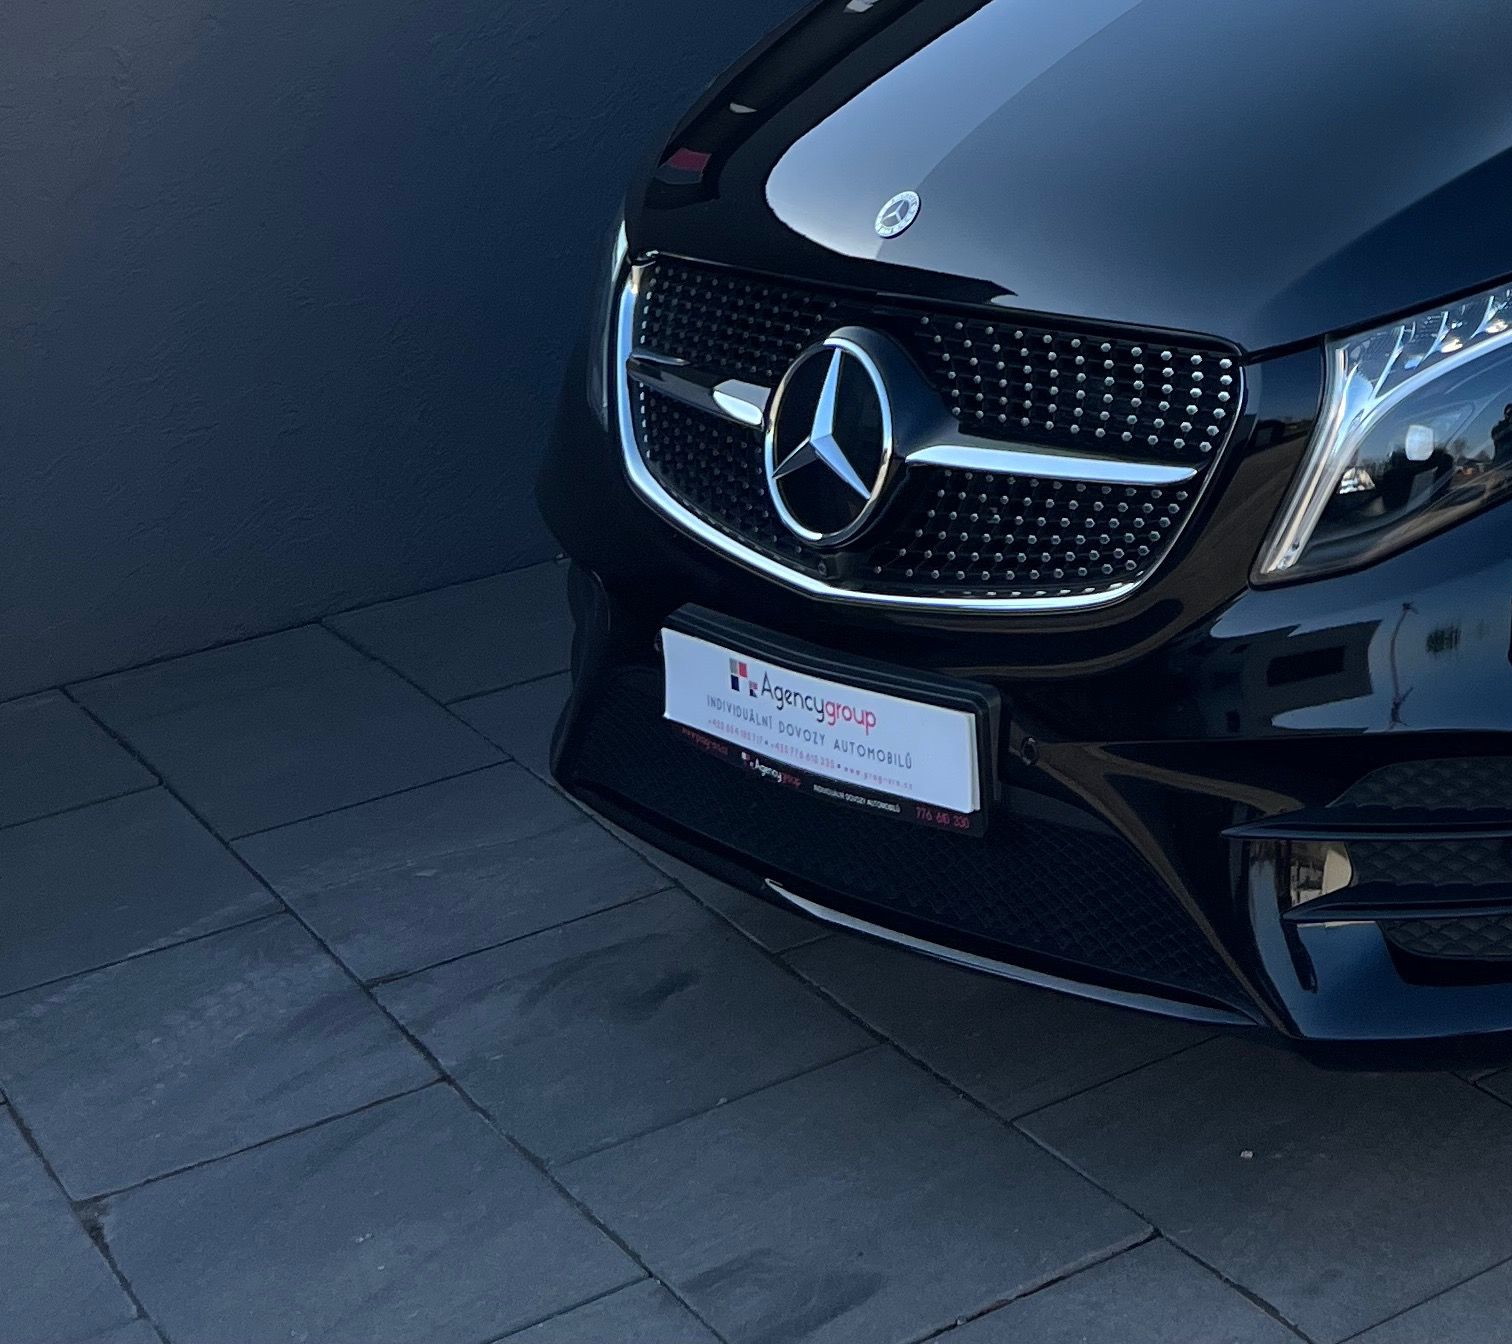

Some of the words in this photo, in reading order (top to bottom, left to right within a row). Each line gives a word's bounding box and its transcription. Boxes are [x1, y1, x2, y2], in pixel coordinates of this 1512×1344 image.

[760, 670, 877, 736] Agencygroup
[778, 720, 826, 747] DOVOZY
[833, 738, 913, 770] AUTOMOBILŮ
